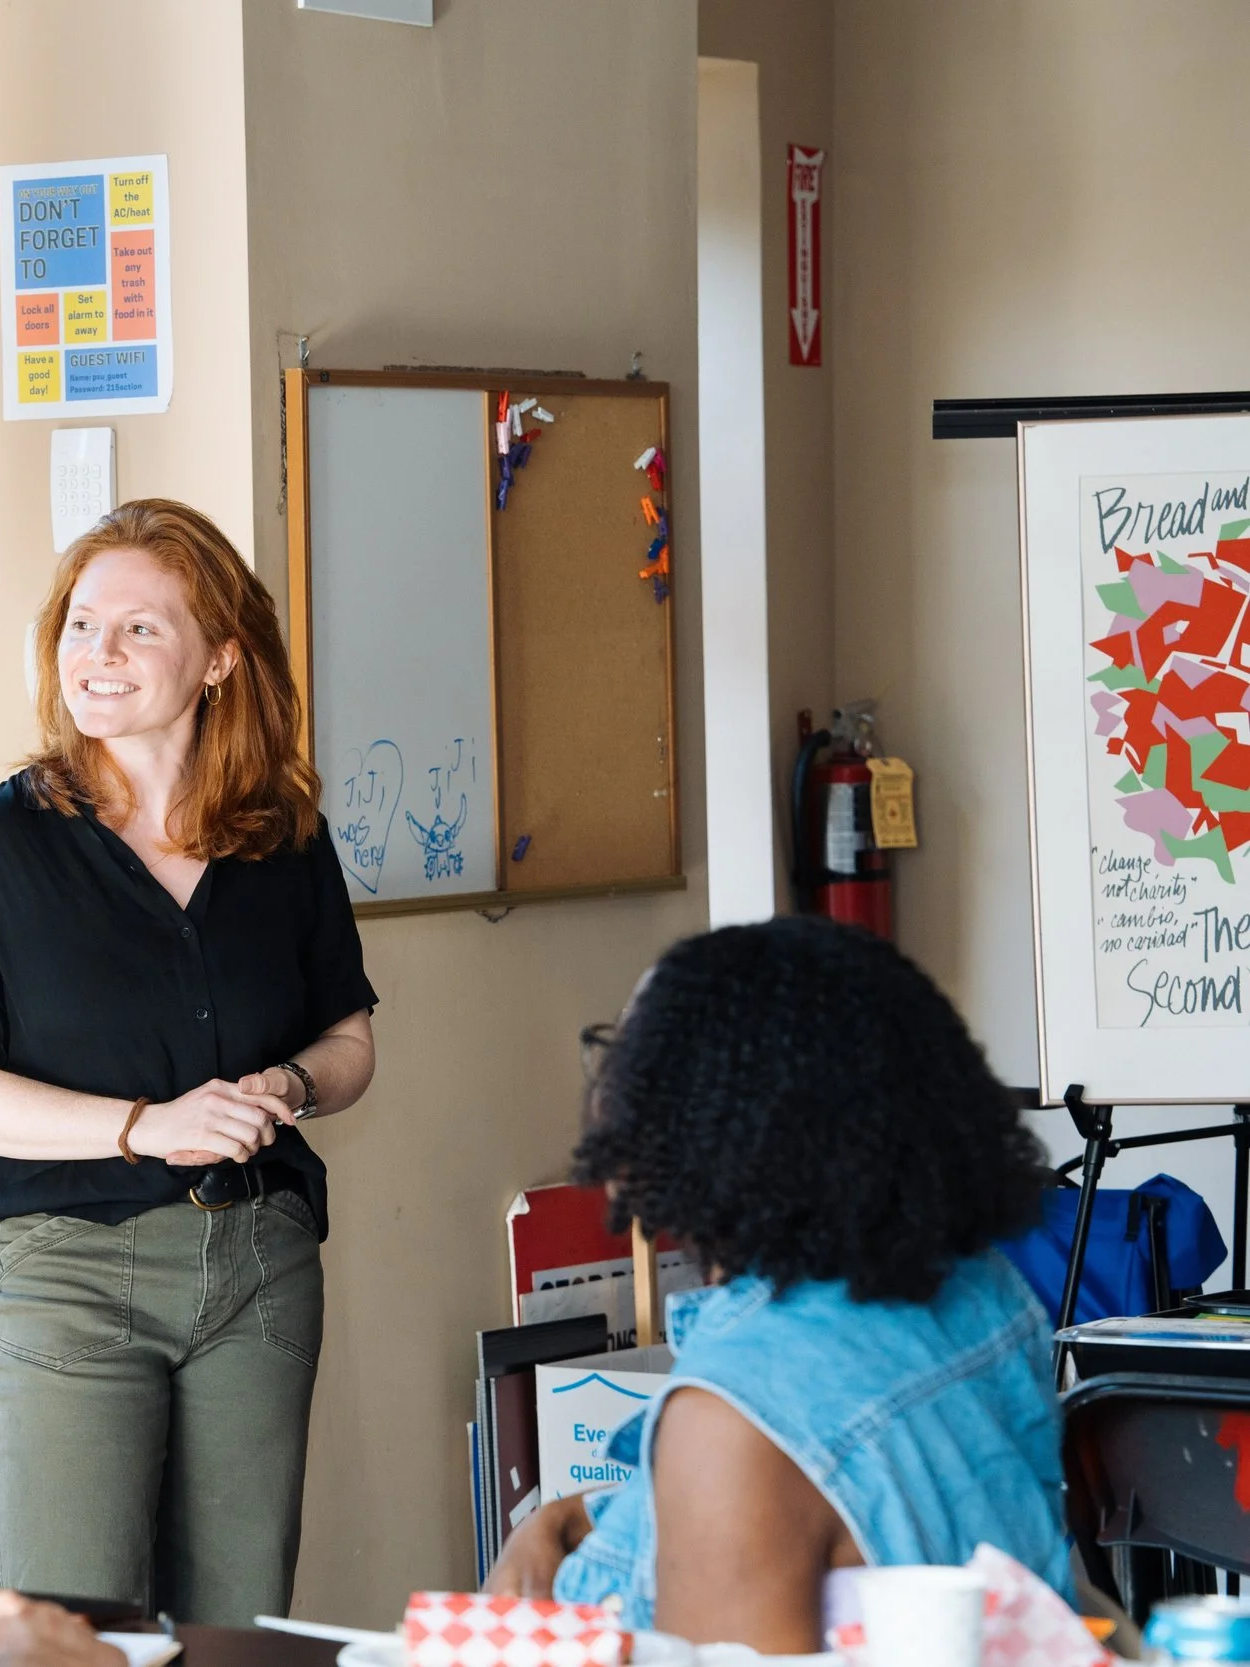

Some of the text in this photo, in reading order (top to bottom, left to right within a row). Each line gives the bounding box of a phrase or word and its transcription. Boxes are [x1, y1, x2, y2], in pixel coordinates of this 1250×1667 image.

[114, 174, 149, 187] Turn off
[124, 192, 140, 202] the
[20, 199, 80, 222] DON'T
[114, 207, 150, 218] AC/heat
[20, 226, 100, 251] FORGET
[114, 246, 152, 258] Take out
[21, 258, 47, 280] TO
[124, 264, 142, 274] any
[122, 278, 146, 288] trash
[78, 294, 94, 304] Set
[124, 293, 144, 304] with
[22, 304, 55, 316] Lock all
[68, 310, 104, 320] alarm to
[114, 308, 154, 320] food in it
[25, 320, 50, 330] doors
[74, 328, 98, 336] away
[24, 354, 54, 365] Have a
[70, 352, 146, 368] GUEST WIFI
[28, 370, 50, 382] good
[70, 374, 92, 382] Name:
[29, 384, 48, 396] day!
[70, 384, 106, 394] Password:
[1092, 476, 1250, 554] Bread and
[338, 816, 370, 846] was
[354, 844, 385, 868] here
[1102, 874, 1130, 898] not
[1193, 906, 1250, 963] The
[1101, 937, 1122, 953] no
[1126, 958, 1242, 1028] Second
